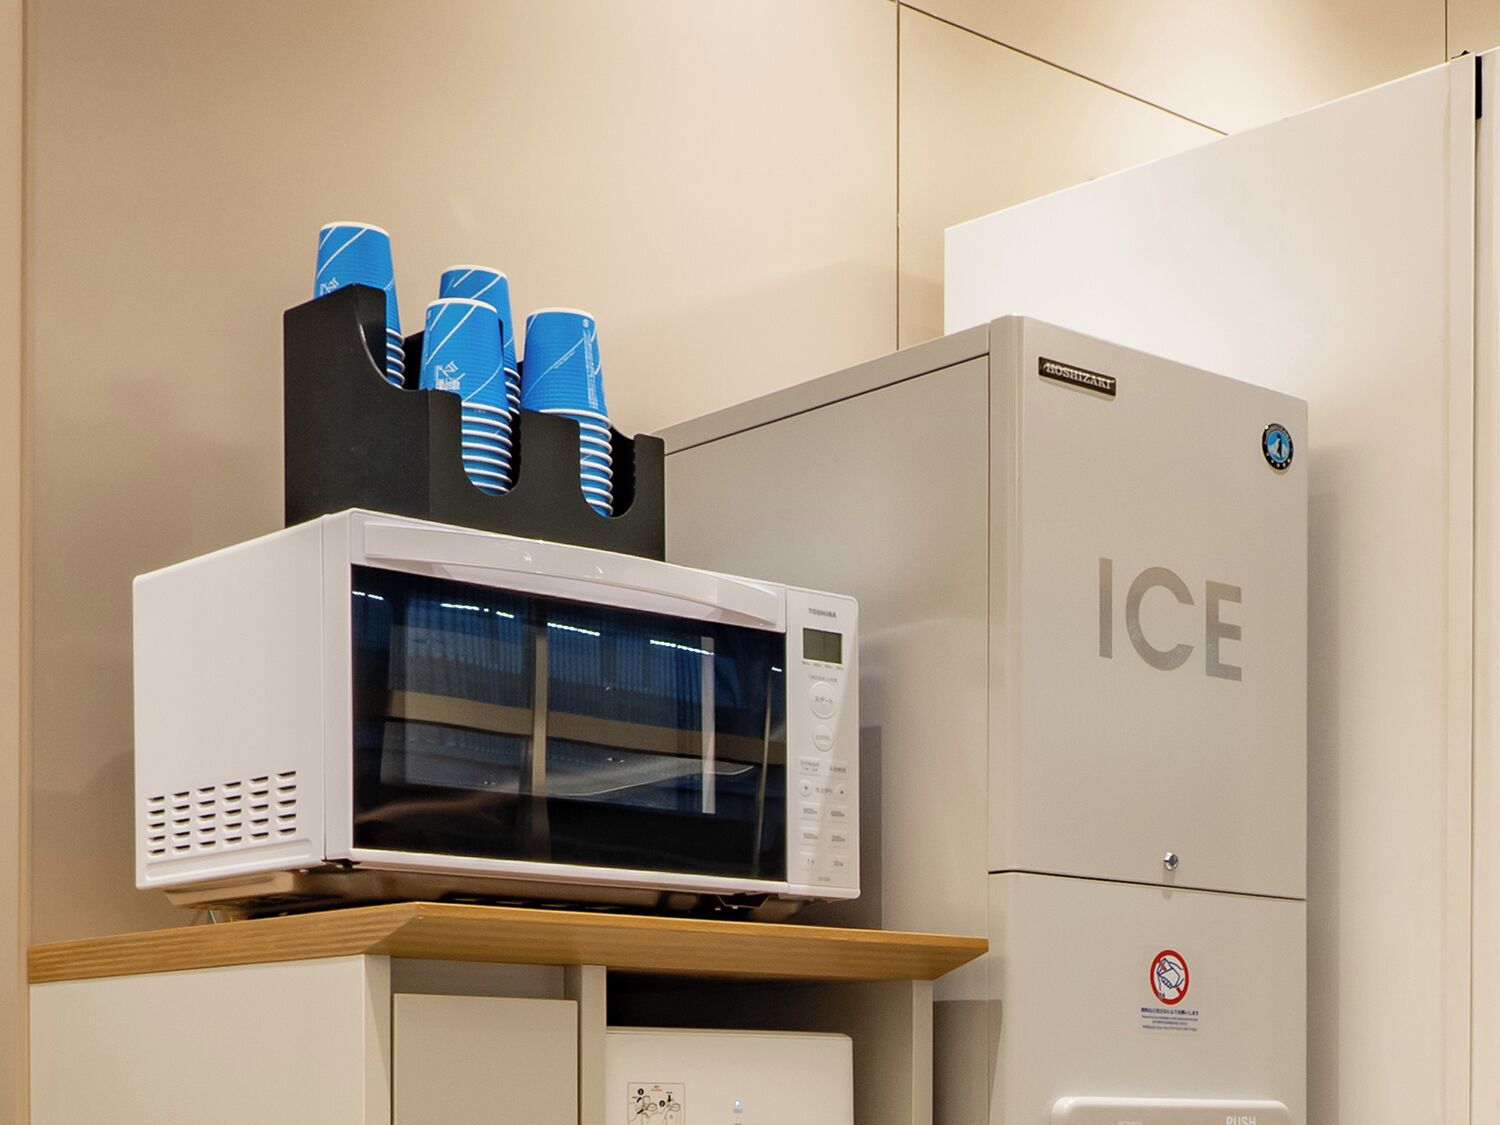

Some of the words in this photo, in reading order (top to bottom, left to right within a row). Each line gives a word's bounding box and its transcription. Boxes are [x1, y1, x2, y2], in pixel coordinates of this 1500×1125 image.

[1043, 362, 1114, 391] HOSHIZAKI
[808, 607, 837, 618] TOSHIBA
[1098, 556, 1243, 683] ICE
